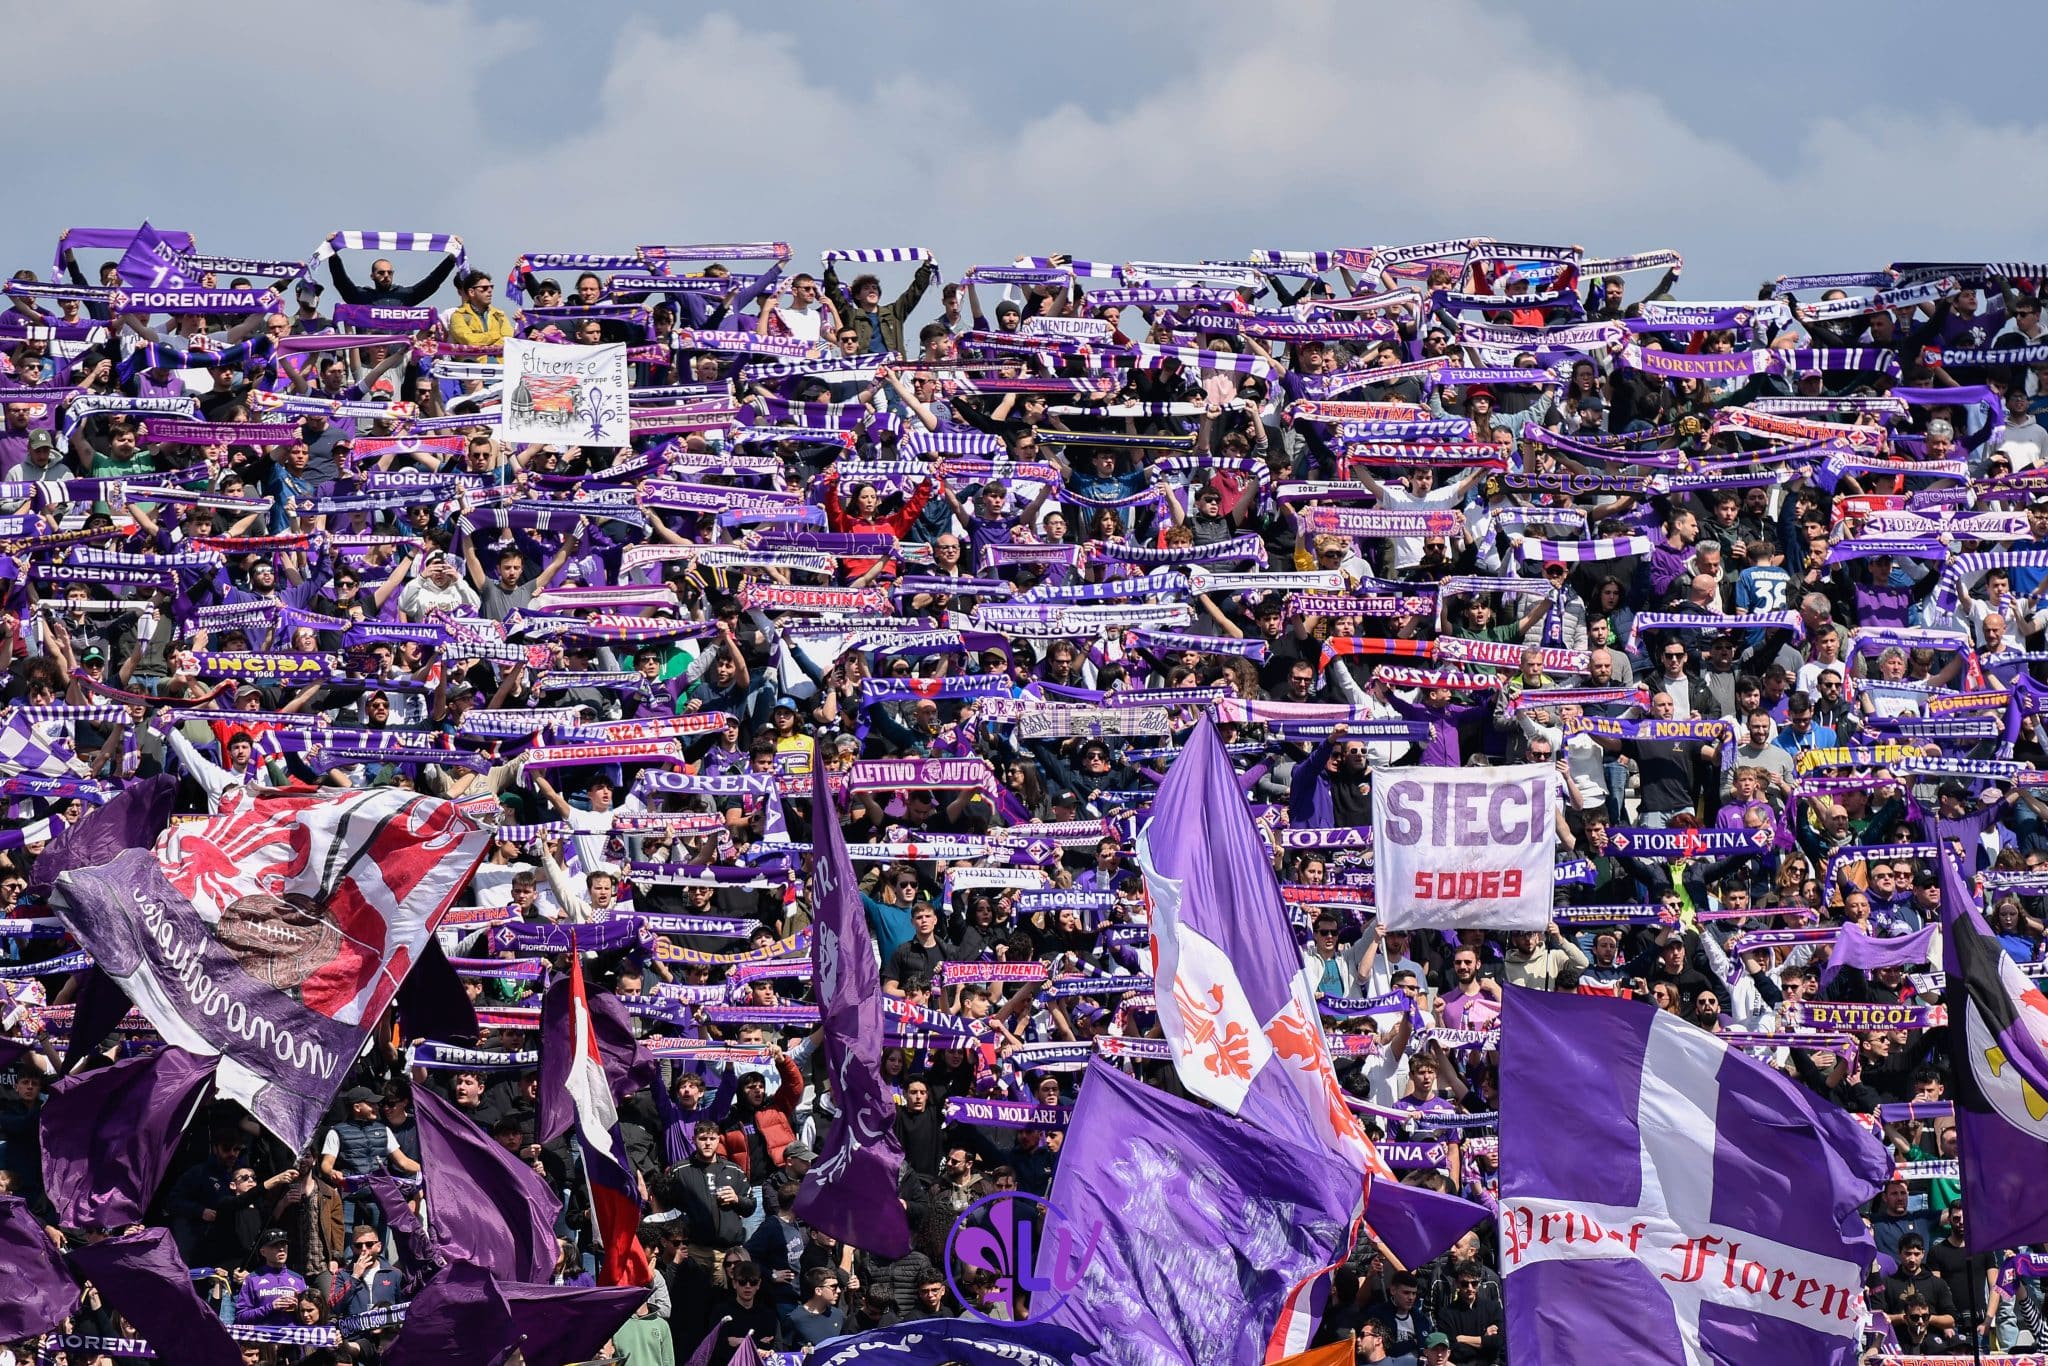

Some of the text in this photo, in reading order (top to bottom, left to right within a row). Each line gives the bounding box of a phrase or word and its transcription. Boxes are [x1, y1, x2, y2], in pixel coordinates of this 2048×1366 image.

[612, 278, 721, 292] FIORENTINA
[131, 291, 256, 308] FIORENTINA
[1828, 287, 1931, 313] AMO VIOLA
[371, 307, 430, 320] FIRENZE
[1268, 322, 1372, 337] FIORENTINA
[694, 330, 810, 350] FORZA VIOLA
[719, 341, 747, 352] JUVE
[1647, 353, 1747, 373] FIORENTINA
[1943, 346, 2048, 365] COLLETTIVO
[1450, 368, 1533, 380] FIORENTINA
[592, 454, 650, 480] FIRENZE
[374, 472, 484, 489] FIORENTINA
[1504, 472, 1643, 496] CICLONE
[1669, 473, 1706, 487] FORZA
[662, 483, 778, 510] Forza Viola
[1338, 513, 1428, 531] FIORENTINA
[1885, 518, 2006, 534] FORZA RAGAZZI
[699, 550, 826, 569] COLLETTIVO AUTONOMO
[38, 564, 163, 584] FIORENTINA
[769, 589, 866, 607] FIORENTINA
[1301, 598, 1395, 611] FIORENTINA
[365, 624, 439, 640] FIORENTINA
[207, 656, 322, 674] INCISA
[1119, 688, 1225, 704] FIORENTINA
[673, 713, 725, 732] VIOLA
[1655, 721, 1690, 737] NON
[1386, 778, 1547, 848] SIECI
[1633, 831, 1748, 851] FIORENTINA
[1867, 846, 1915, 861] CLUB
[1112, 928, 1137, 942] ACF
[520, 943, 568, 953] FIORENTINA
[948, 965, 979, 979] FORZA
[1328, 995, 1401, 1010] FIORENTINA
[1812, 1008, 1918, 1024] BATIGOL
[435, 1046, 511, 1064] FIRENZE
[966, 1102, 1057, 1125] NON MOLLARE
[259, 1286, 296, 1299] Mediacom
